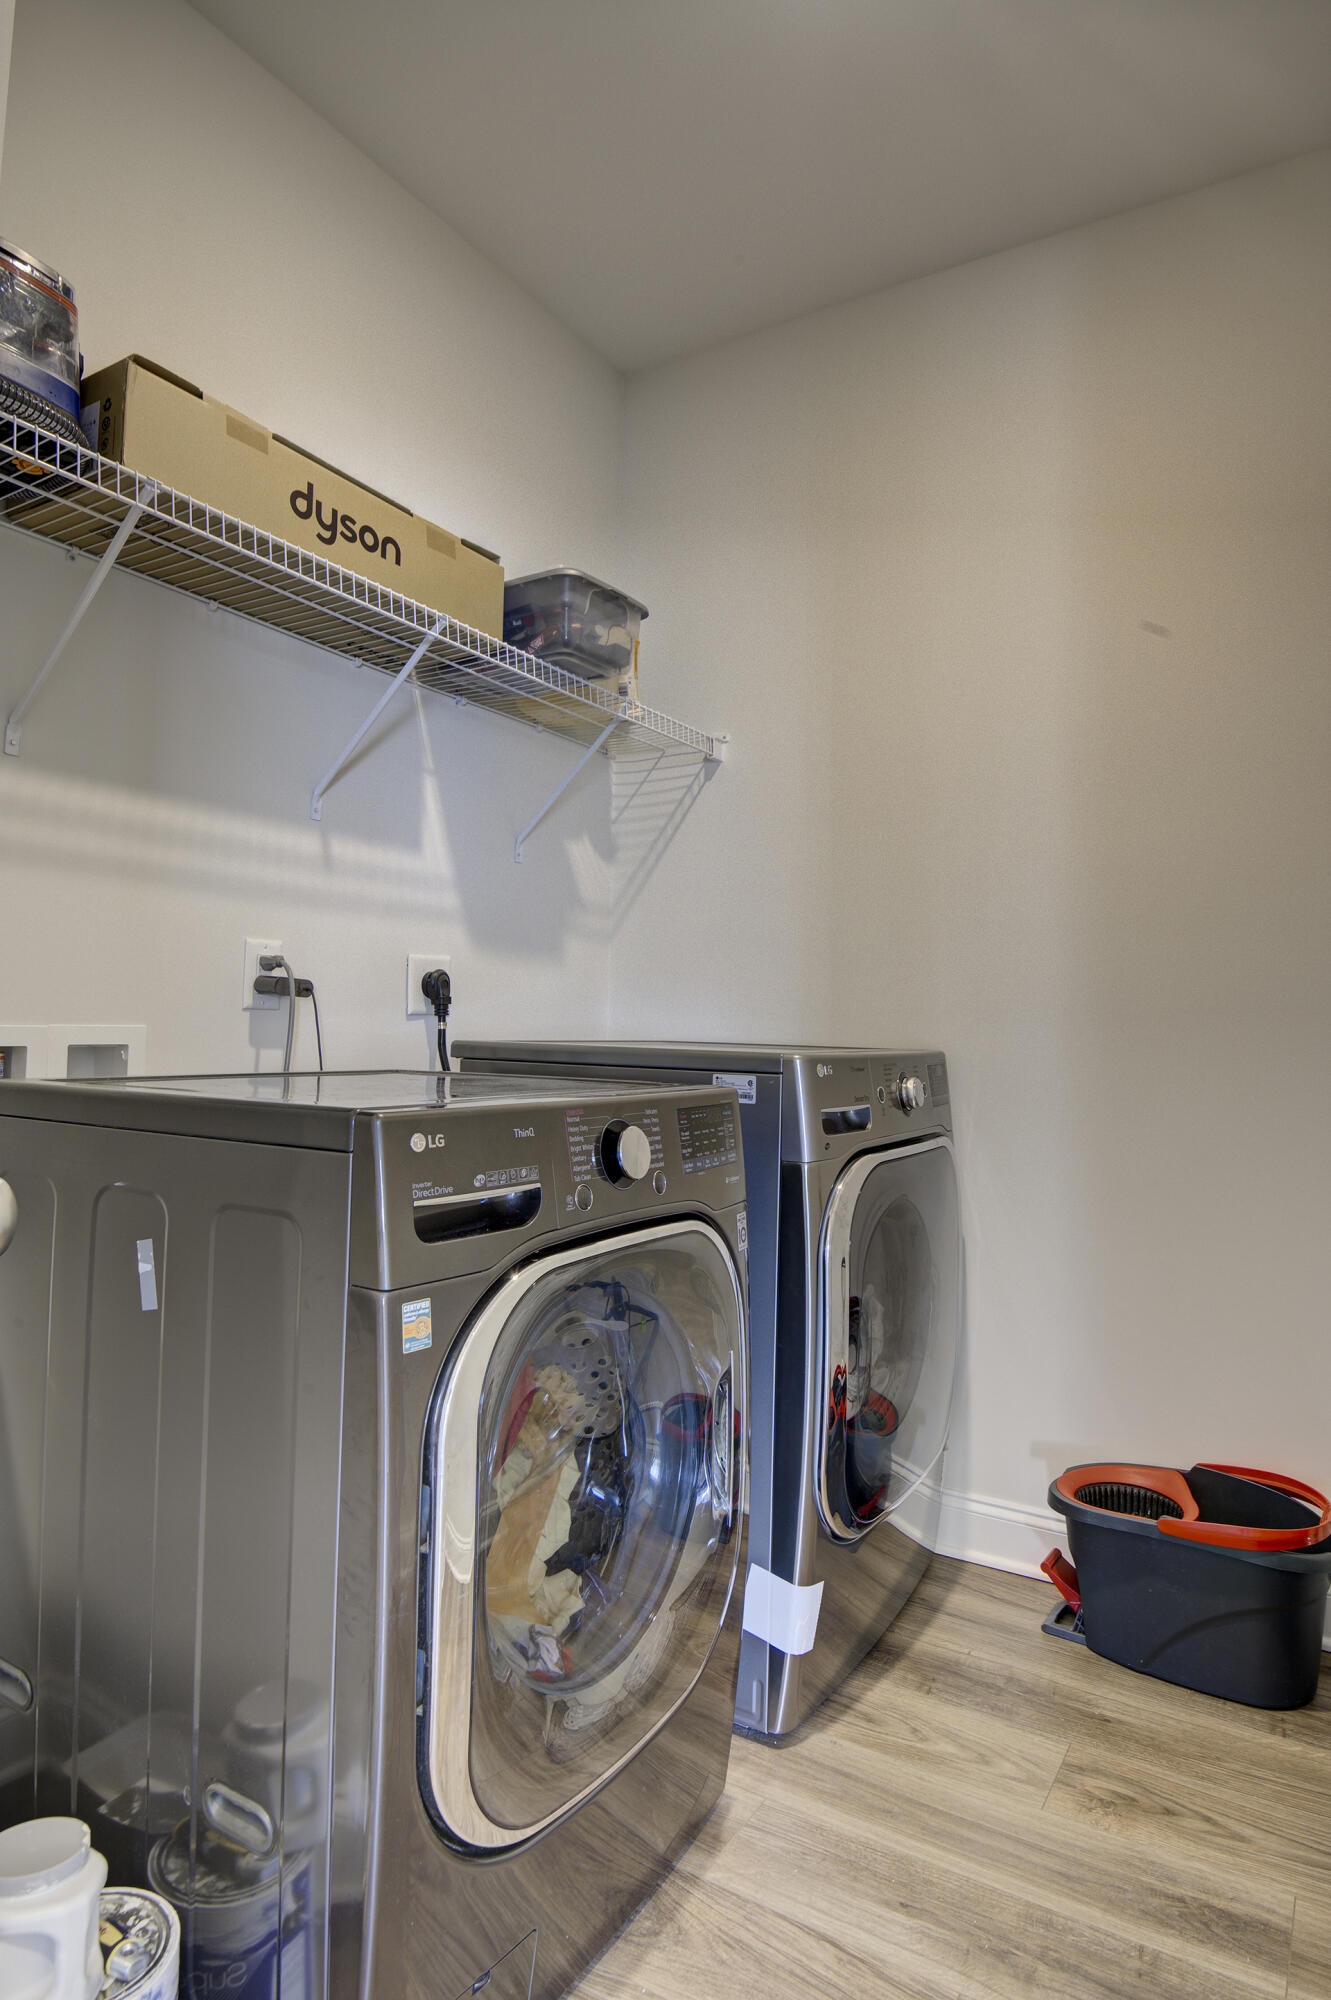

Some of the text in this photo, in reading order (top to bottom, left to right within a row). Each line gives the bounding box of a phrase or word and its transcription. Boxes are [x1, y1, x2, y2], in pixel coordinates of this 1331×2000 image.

[289, 481, 401, 567] dyson
[823, 1064, 833, 1076] LG
[513, 1127, 535, 1139] ThinQ
[427, 1133, 446, 1149] LG
[412, 1181, 433, 1189] Inverter
